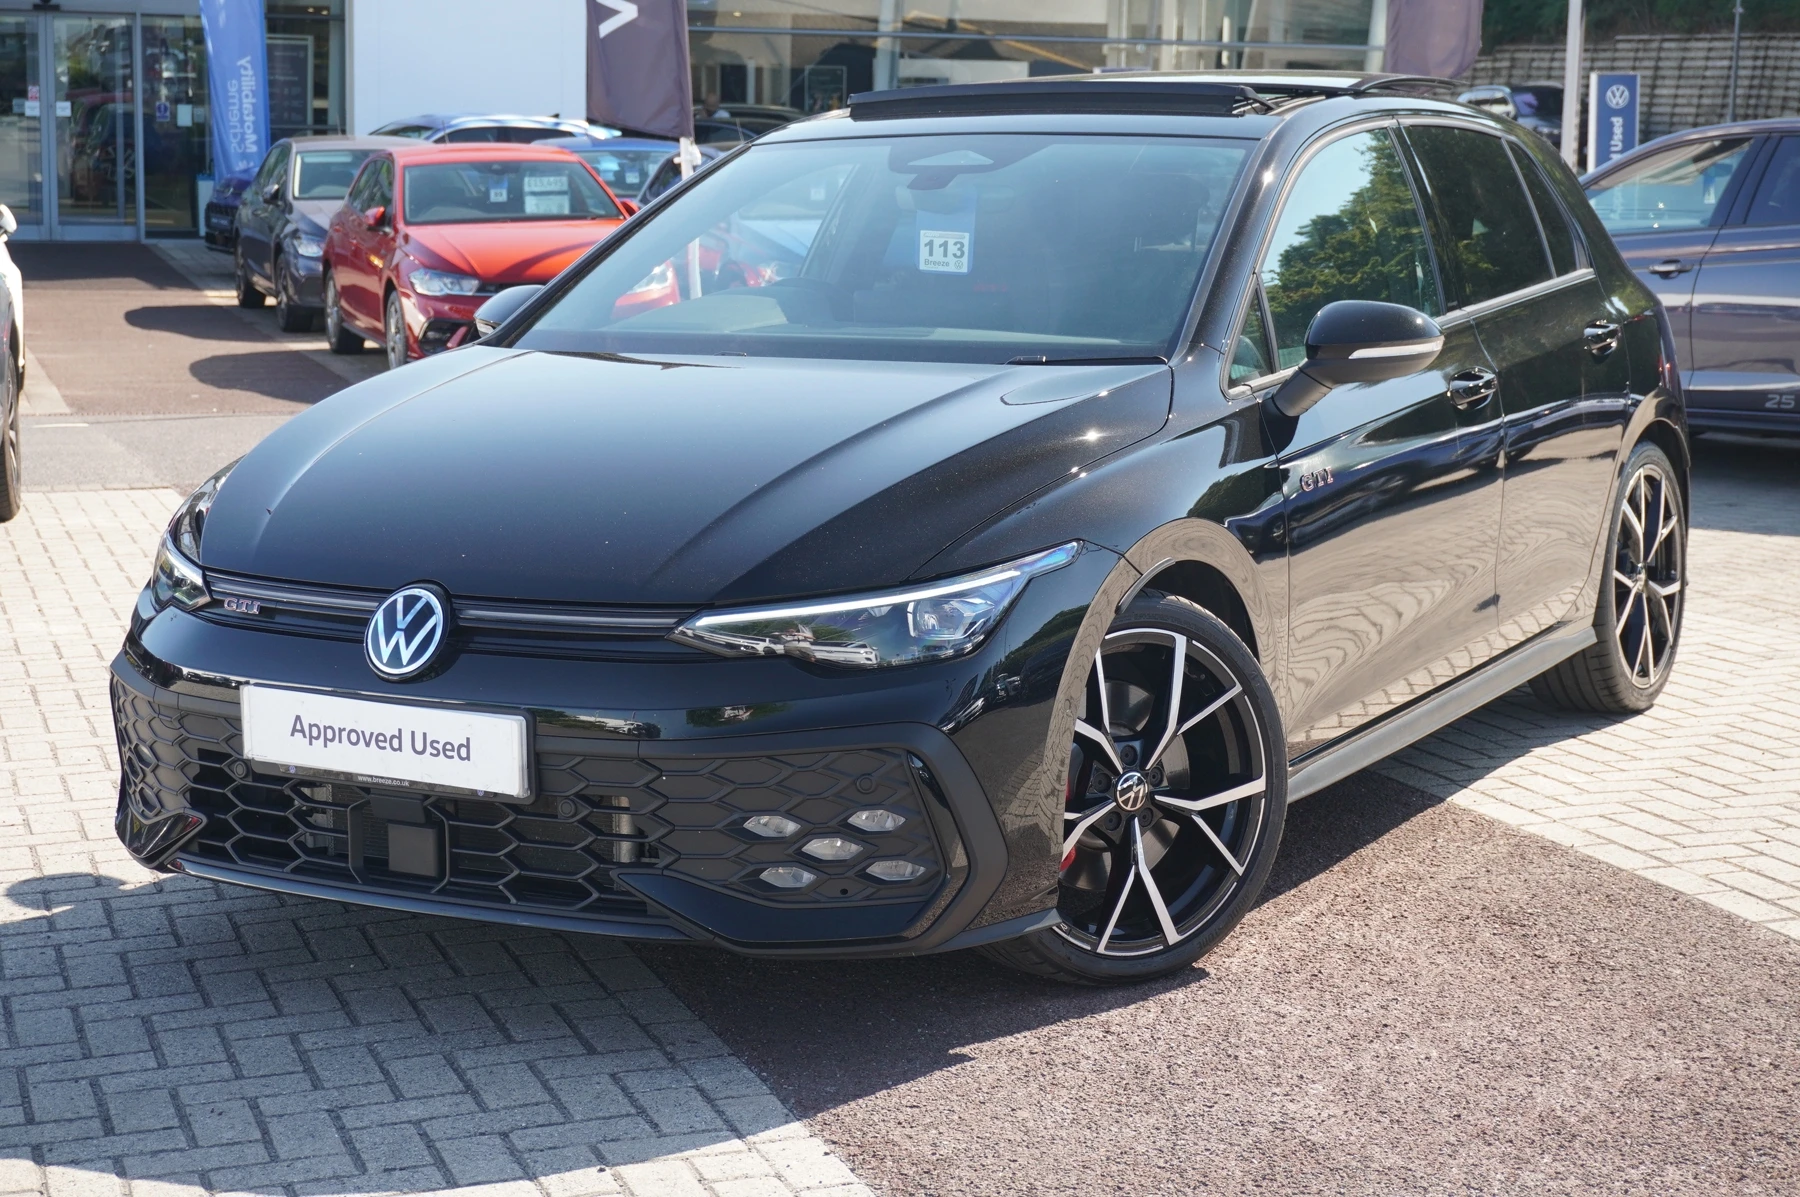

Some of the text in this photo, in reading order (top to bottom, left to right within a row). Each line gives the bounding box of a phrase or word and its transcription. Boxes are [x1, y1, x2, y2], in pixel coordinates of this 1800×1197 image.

[1609, 116, 1624, 151] Used
[924, 239, 965, 259] 113
[924, 258, 950, 267] Breeze
[1764, 393, 1796, 409] 25
[1300, 466, 1334, 491] GTI
[224, 597, 261, 615] GTI
[290, 714, 471, 762] Approved Used
[357, 775, 410, 787] www.breeze.co.uk
